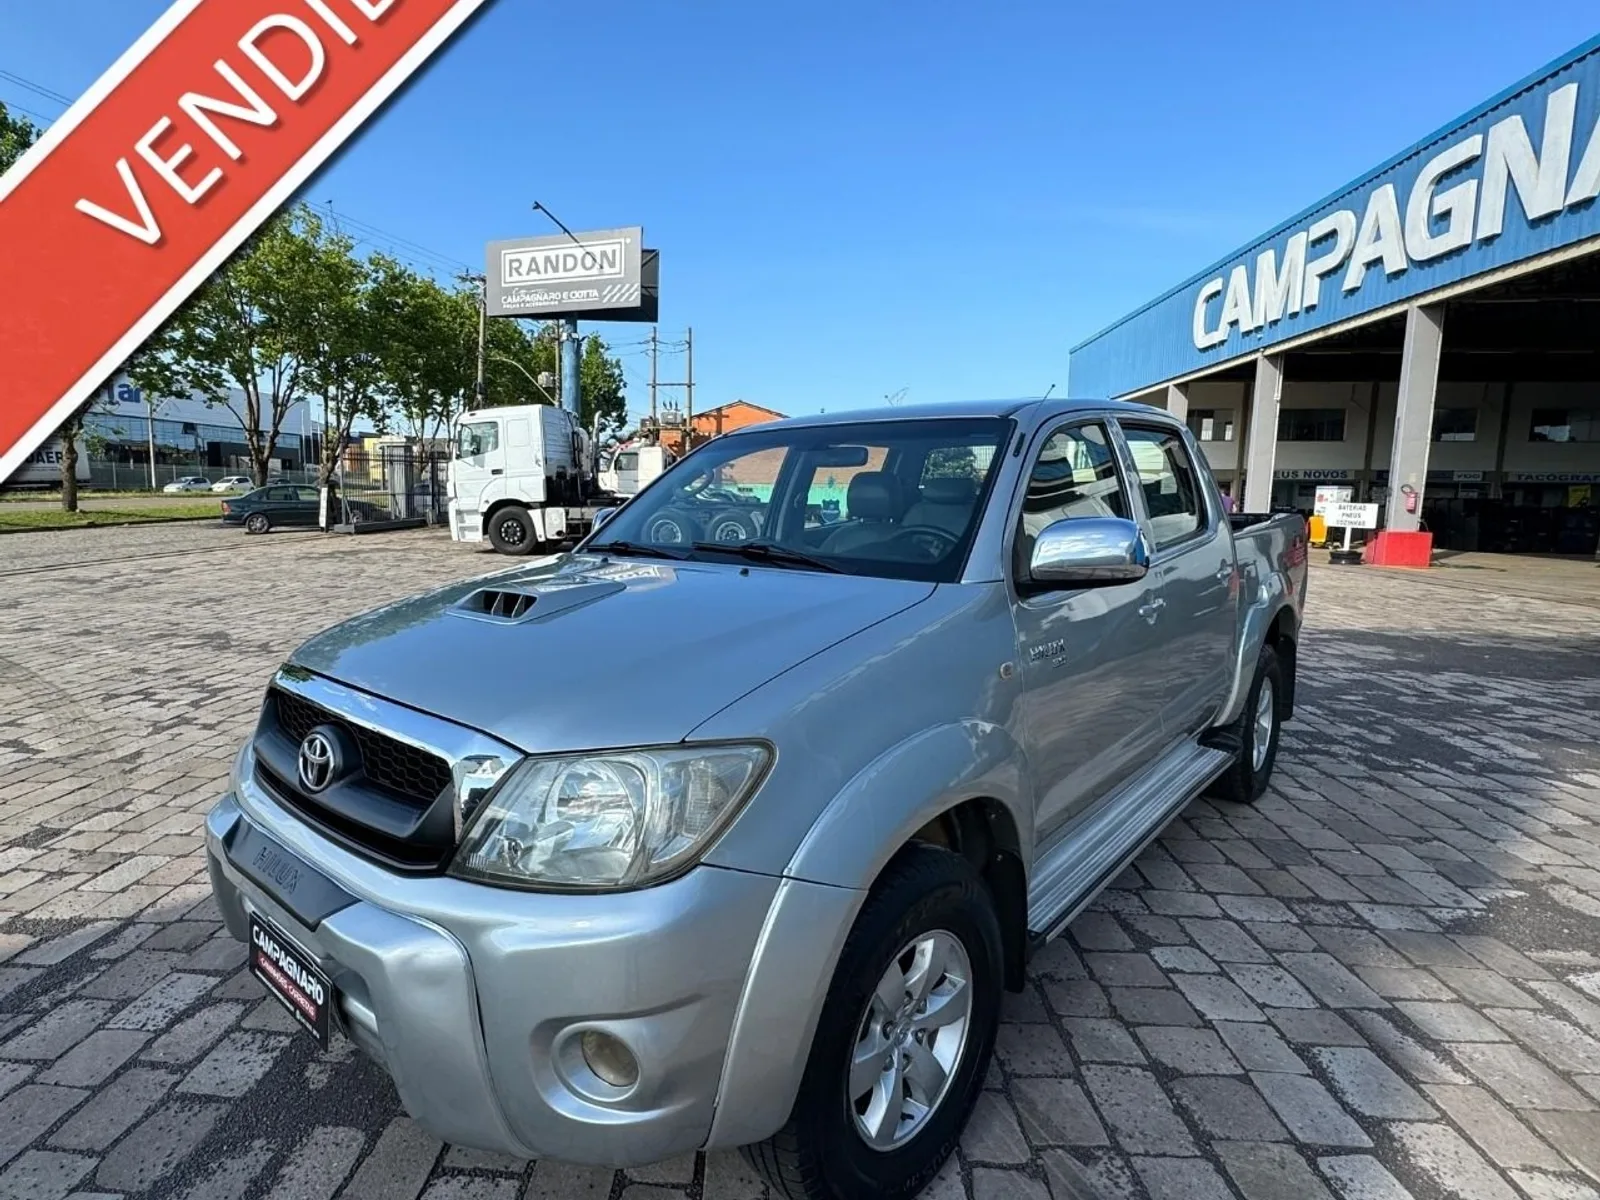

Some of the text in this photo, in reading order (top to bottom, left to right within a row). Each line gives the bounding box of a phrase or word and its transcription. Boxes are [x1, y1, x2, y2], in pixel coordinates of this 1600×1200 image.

[508, 249, 617, 278] RANDON
[501, 291, 561, 304] CAMPAGNARO
[1303, 470, 1348, 479] NOVOS
[252, 846, 299, 894] HILUX
[252, 924, 325, 1006] CAMPAGNARO
